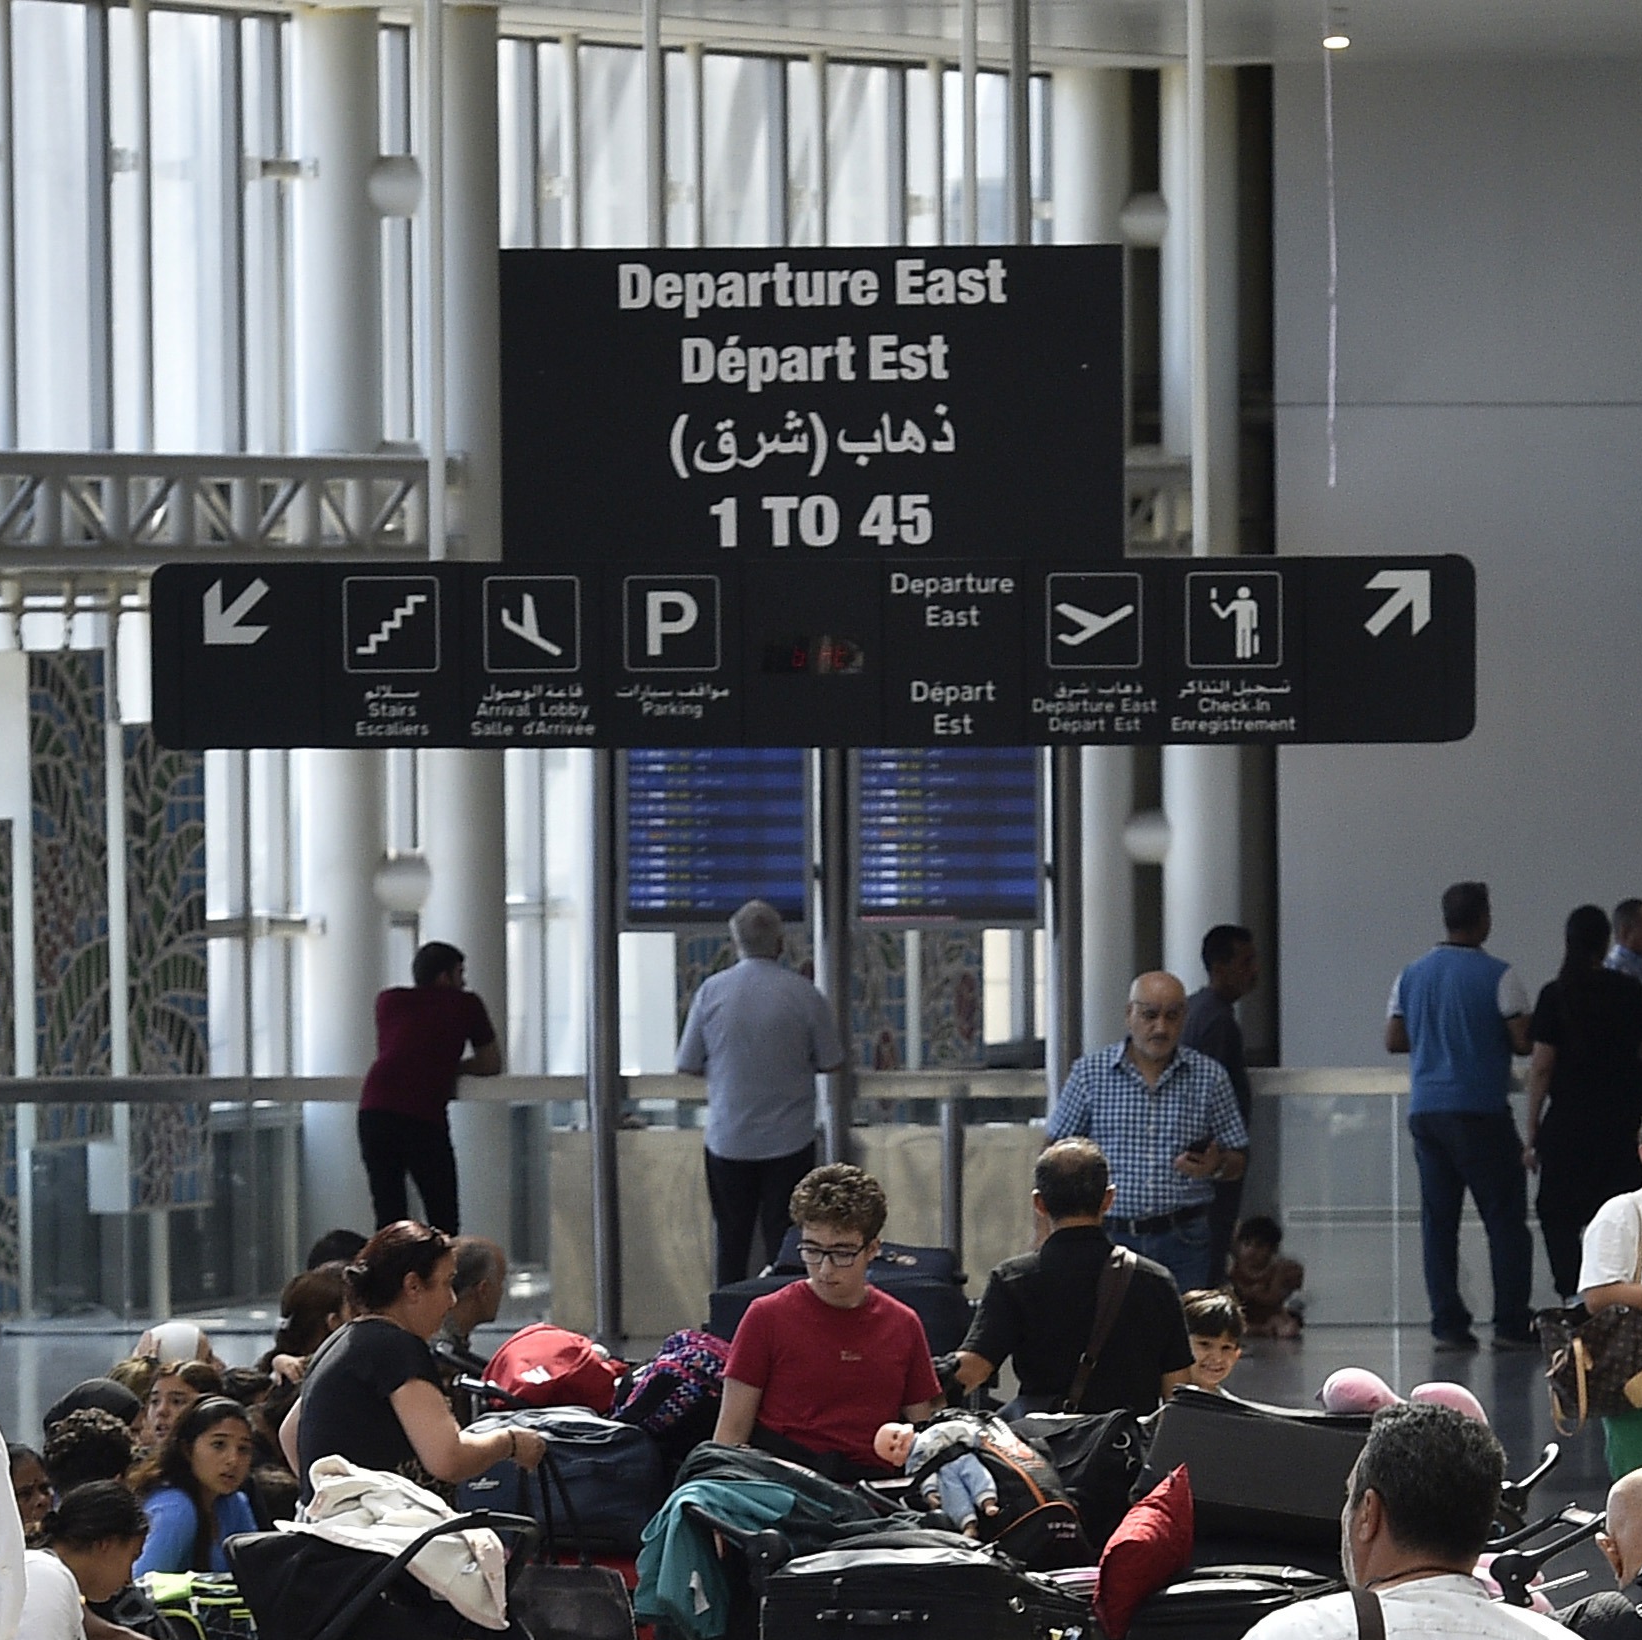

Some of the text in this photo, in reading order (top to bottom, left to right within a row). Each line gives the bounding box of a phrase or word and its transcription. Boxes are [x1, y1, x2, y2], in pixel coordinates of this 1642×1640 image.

[618, 258, 1007, 318] Departure East
[681, 334, 950, 392] Départ Est
[669, 404, 956, 479] ذهاب (شرق)
[709, 494, 933, 548] 1 TO 45
[890, 572, 1015, 599] Departure
[647, 591, 698, 656] P
[925, 605, 980, 627] East
[482, 684, 543, 702] الوصول
[910, 680, 996, 706] Départ
[368, 702, 417, 717] Stairs
[476, 702, 590, 719] Arrival Lobby
[642, 701, 703, 719] Parking
[1032, 697, 1157, 715] Departure East
[356, 721, 430, 736] Escaliers
[471, 720, 514, 736] Salle
[933, 713, 974, 735] Est
[1114, 716, 1140, 732] Est
[1171, 716, 1296, 735] Enregistrement
